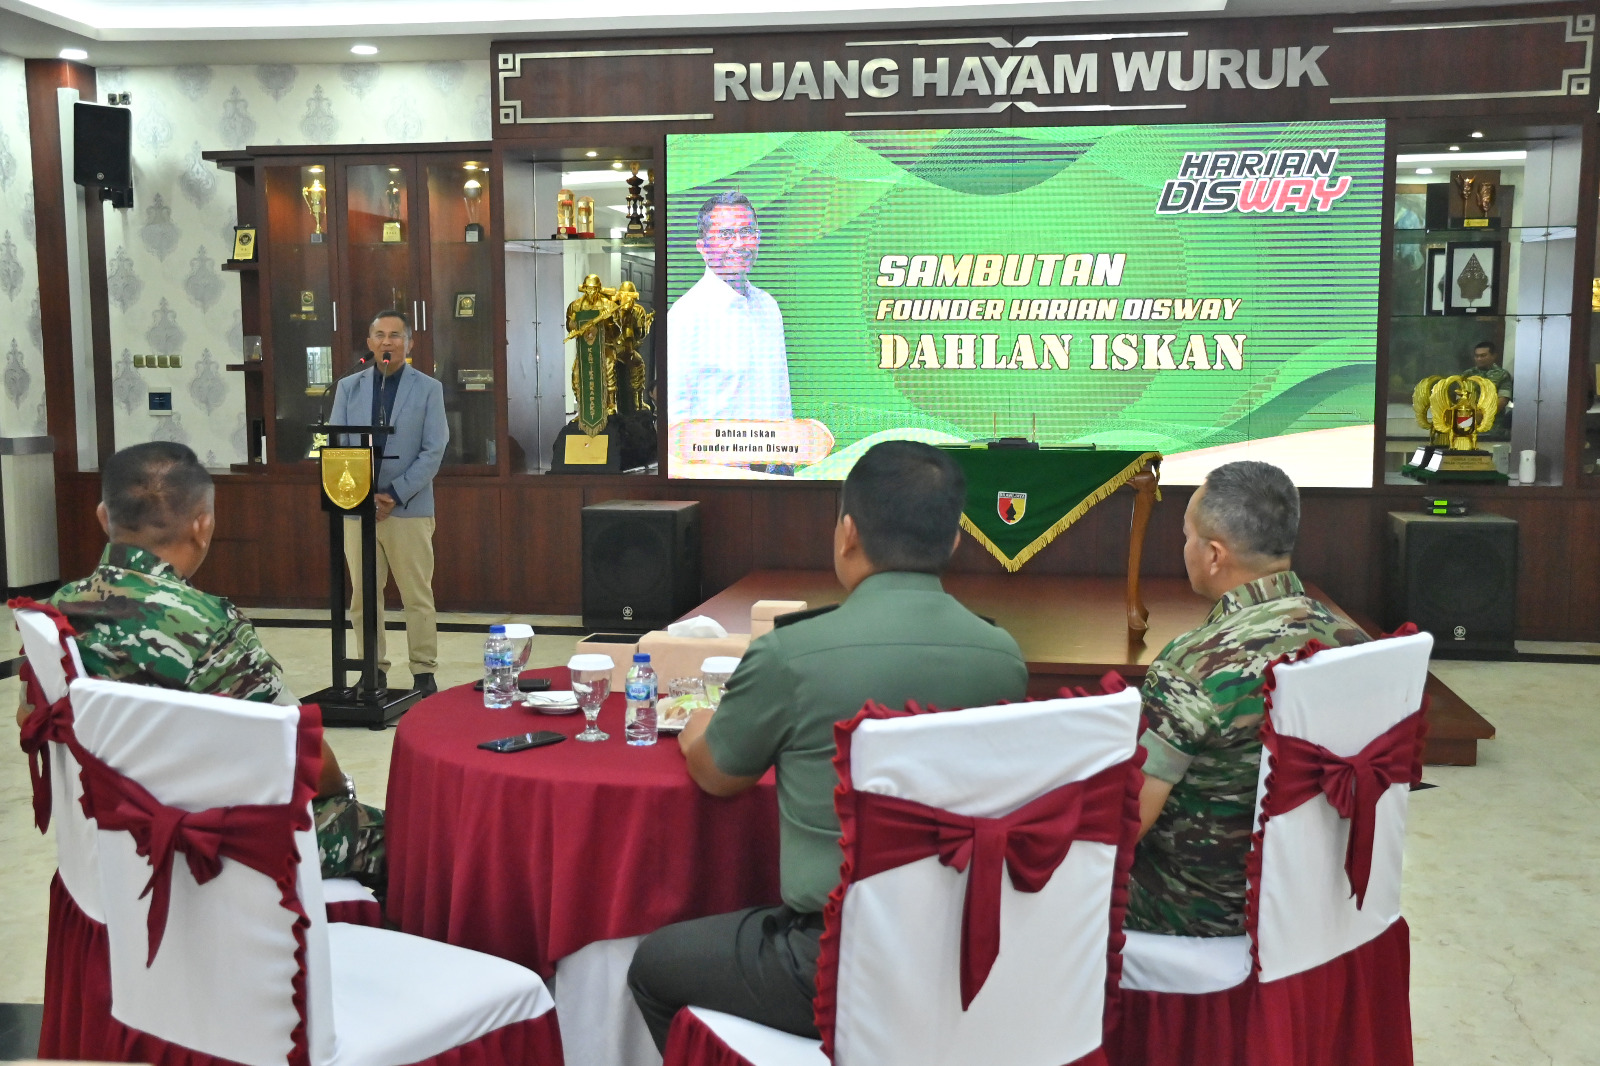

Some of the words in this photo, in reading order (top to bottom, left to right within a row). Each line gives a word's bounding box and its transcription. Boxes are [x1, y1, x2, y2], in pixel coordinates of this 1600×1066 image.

[713, 58, 899, 101] RUANG
[912, 53, 1098, 97] HAYAM
[1111, 45, 1330, 92] WURUK
[1179, 150, 1338, 178] HARIAN
[1156, 178, 1352, 214] DISWAY
[876, 253, 1126, 287] SAMBUTAN
[876, 299, 1004, 321] FOUNDER
[1007, 299, 1118, 321] HARIAN
[1120, 298, 1242, 321] DISWAY
[878, 333, 1073, 370] DAHLAN
[1089, 333, 1247, 371] ISKAN
[692, 443, 730, 452] Founder
[732, 443, 763, 452] Harian
[766, 443, 799, 453] Disway
[715, 429, 747, 438] Dahlan
[750, 429, 776, 438] Iskan
